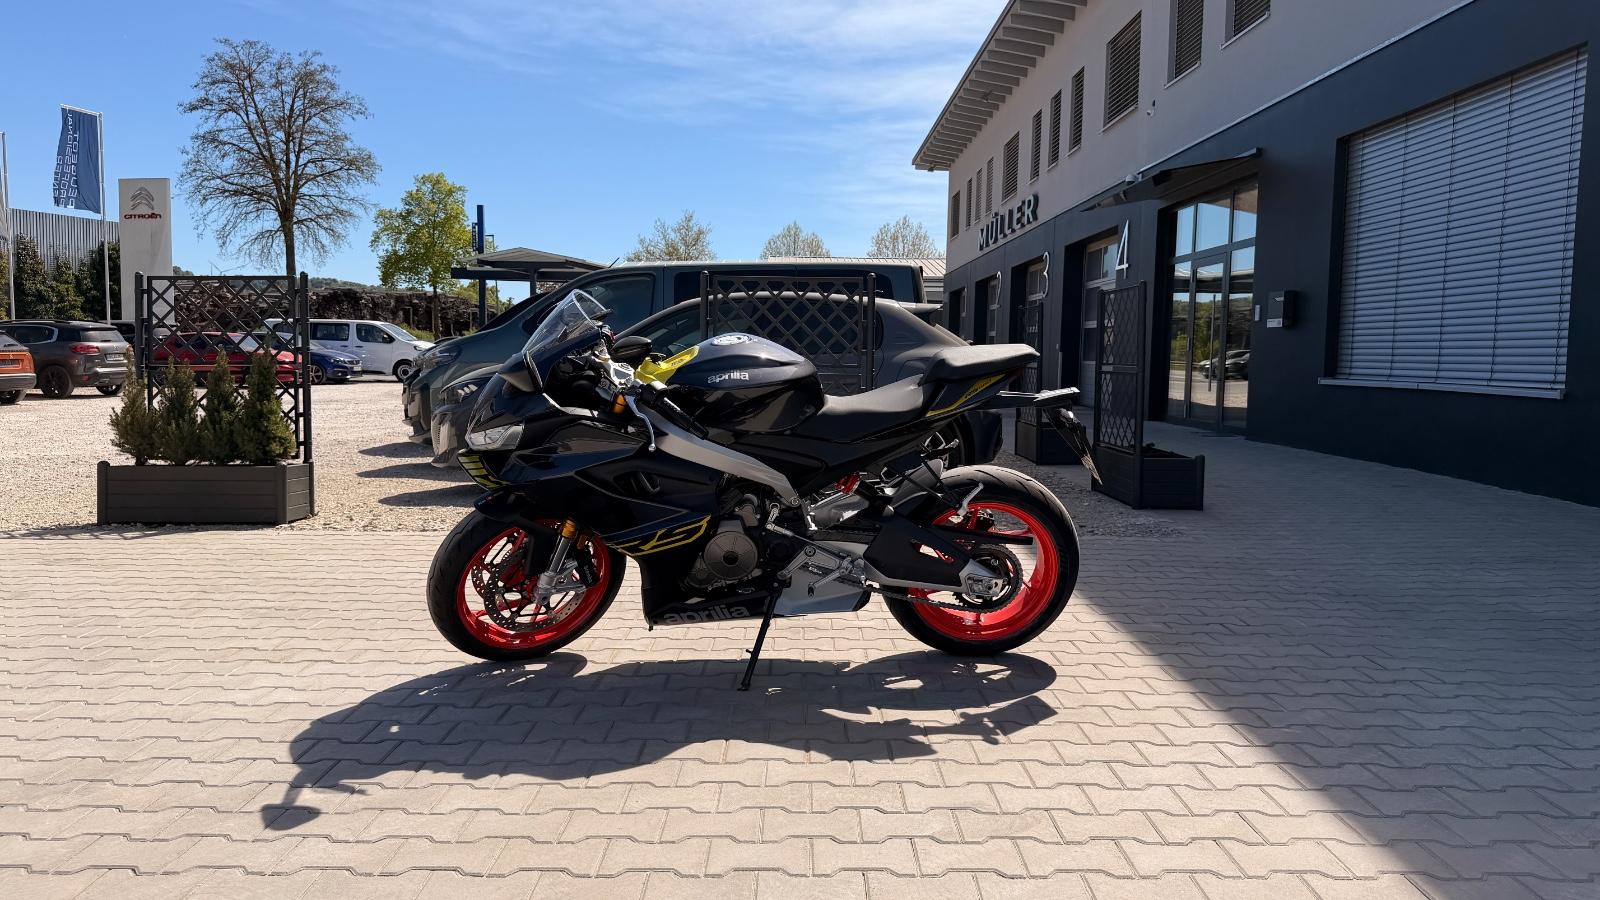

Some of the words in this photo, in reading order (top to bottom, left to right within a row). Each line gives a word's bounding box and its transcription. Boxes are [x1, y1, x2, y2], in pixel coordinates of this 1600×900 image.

[978, 193, 1039, 251] MÜLLER
[1115, 220, 1129, 280] 4
[1042, 251, 1050, 298] 3
[707, 370, 750, 383] aprilia
[663, 604, 751, 625] aprilia
